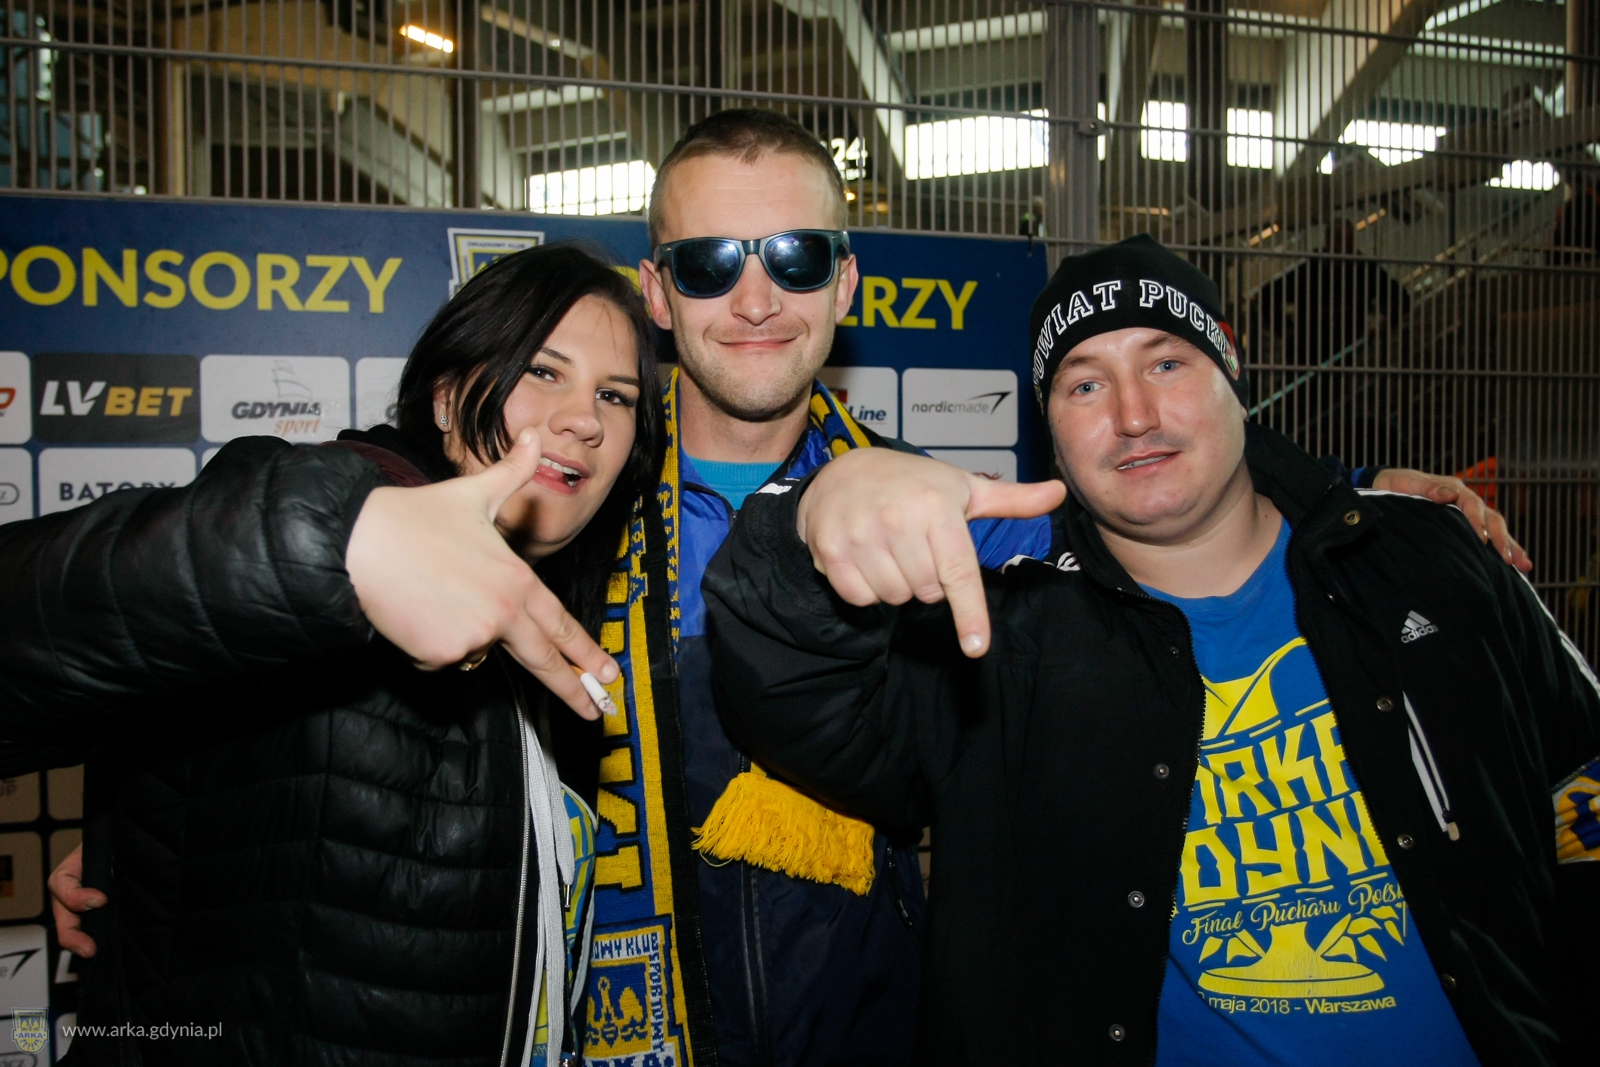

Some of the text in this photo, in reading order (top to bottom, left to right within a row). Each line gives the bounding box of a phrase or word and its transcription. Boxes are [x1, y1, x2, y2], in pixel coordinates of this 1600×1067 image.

[0, 244, 403, 313] ONSORZY
[1032, 279, 1122, 385] OWIAT
[911, 400, 989, 415] nordicmade
[273, 417, 321, 437] sport
[1400, 624, 1439, 644] adidas
[1250, 897, 1342, 931] Pucharu
[1208, 996, 1246, 1014] maja
[1250, 997, 1290, 1014] 2018
[1304, 995, 1397, 1014] Warszawa
